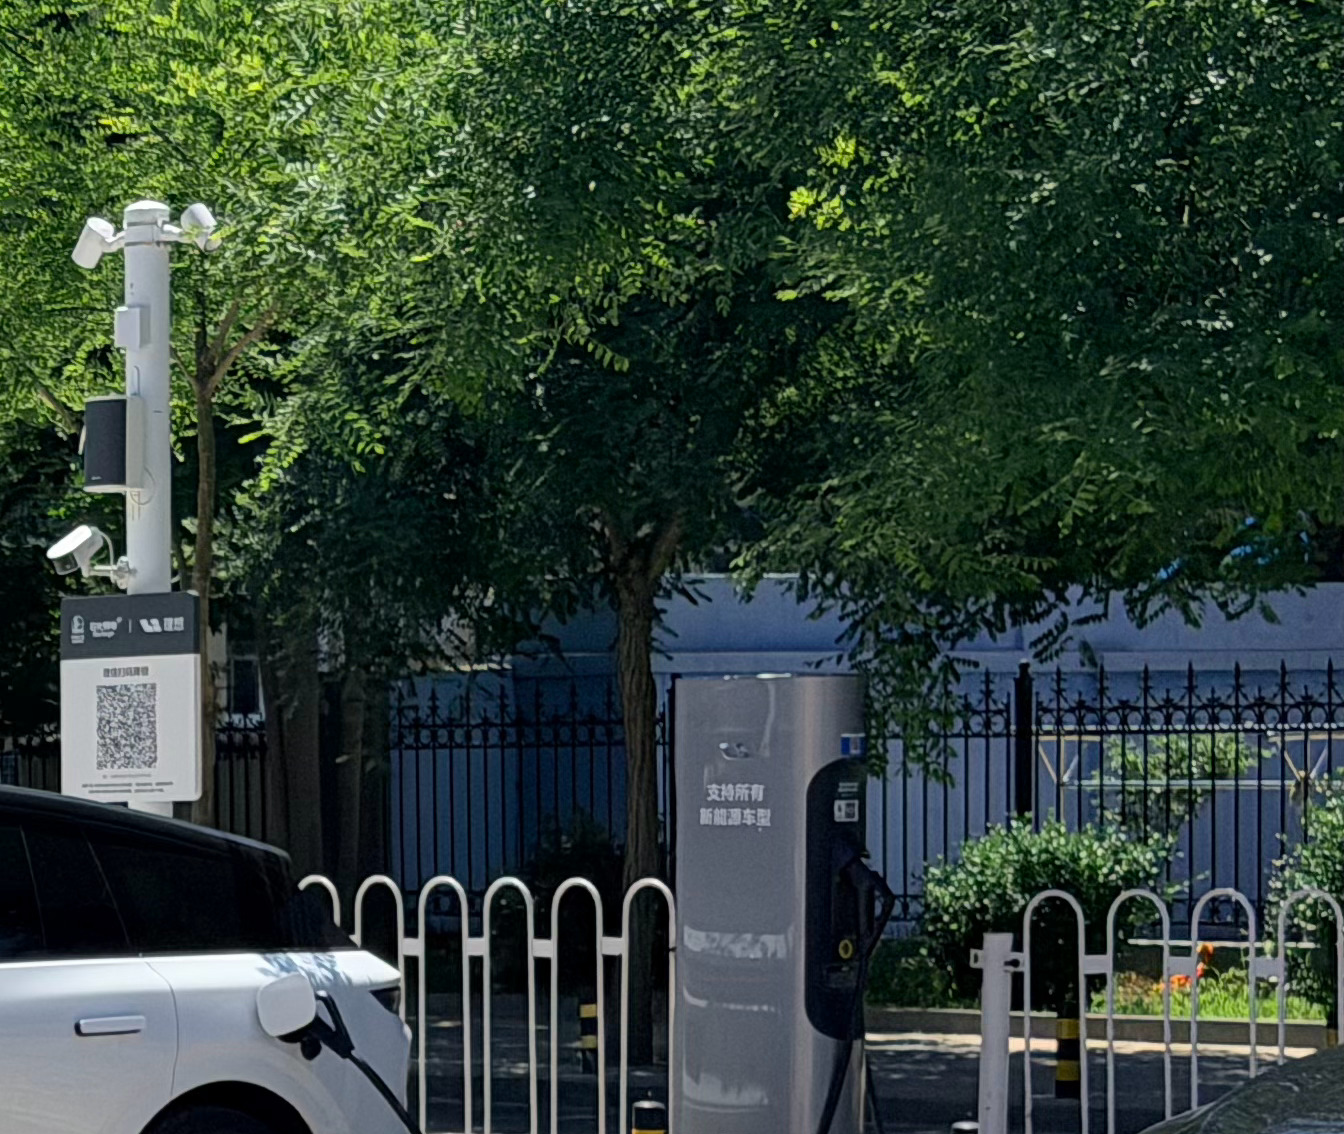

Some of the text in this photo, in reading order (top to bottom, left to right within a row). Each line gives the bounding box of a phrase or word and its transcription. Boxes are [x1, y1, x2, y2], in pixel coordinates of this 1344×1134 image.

[706, 783, 765, 801] 支持所有
[699, 807, 772, 827] 新能源车型
